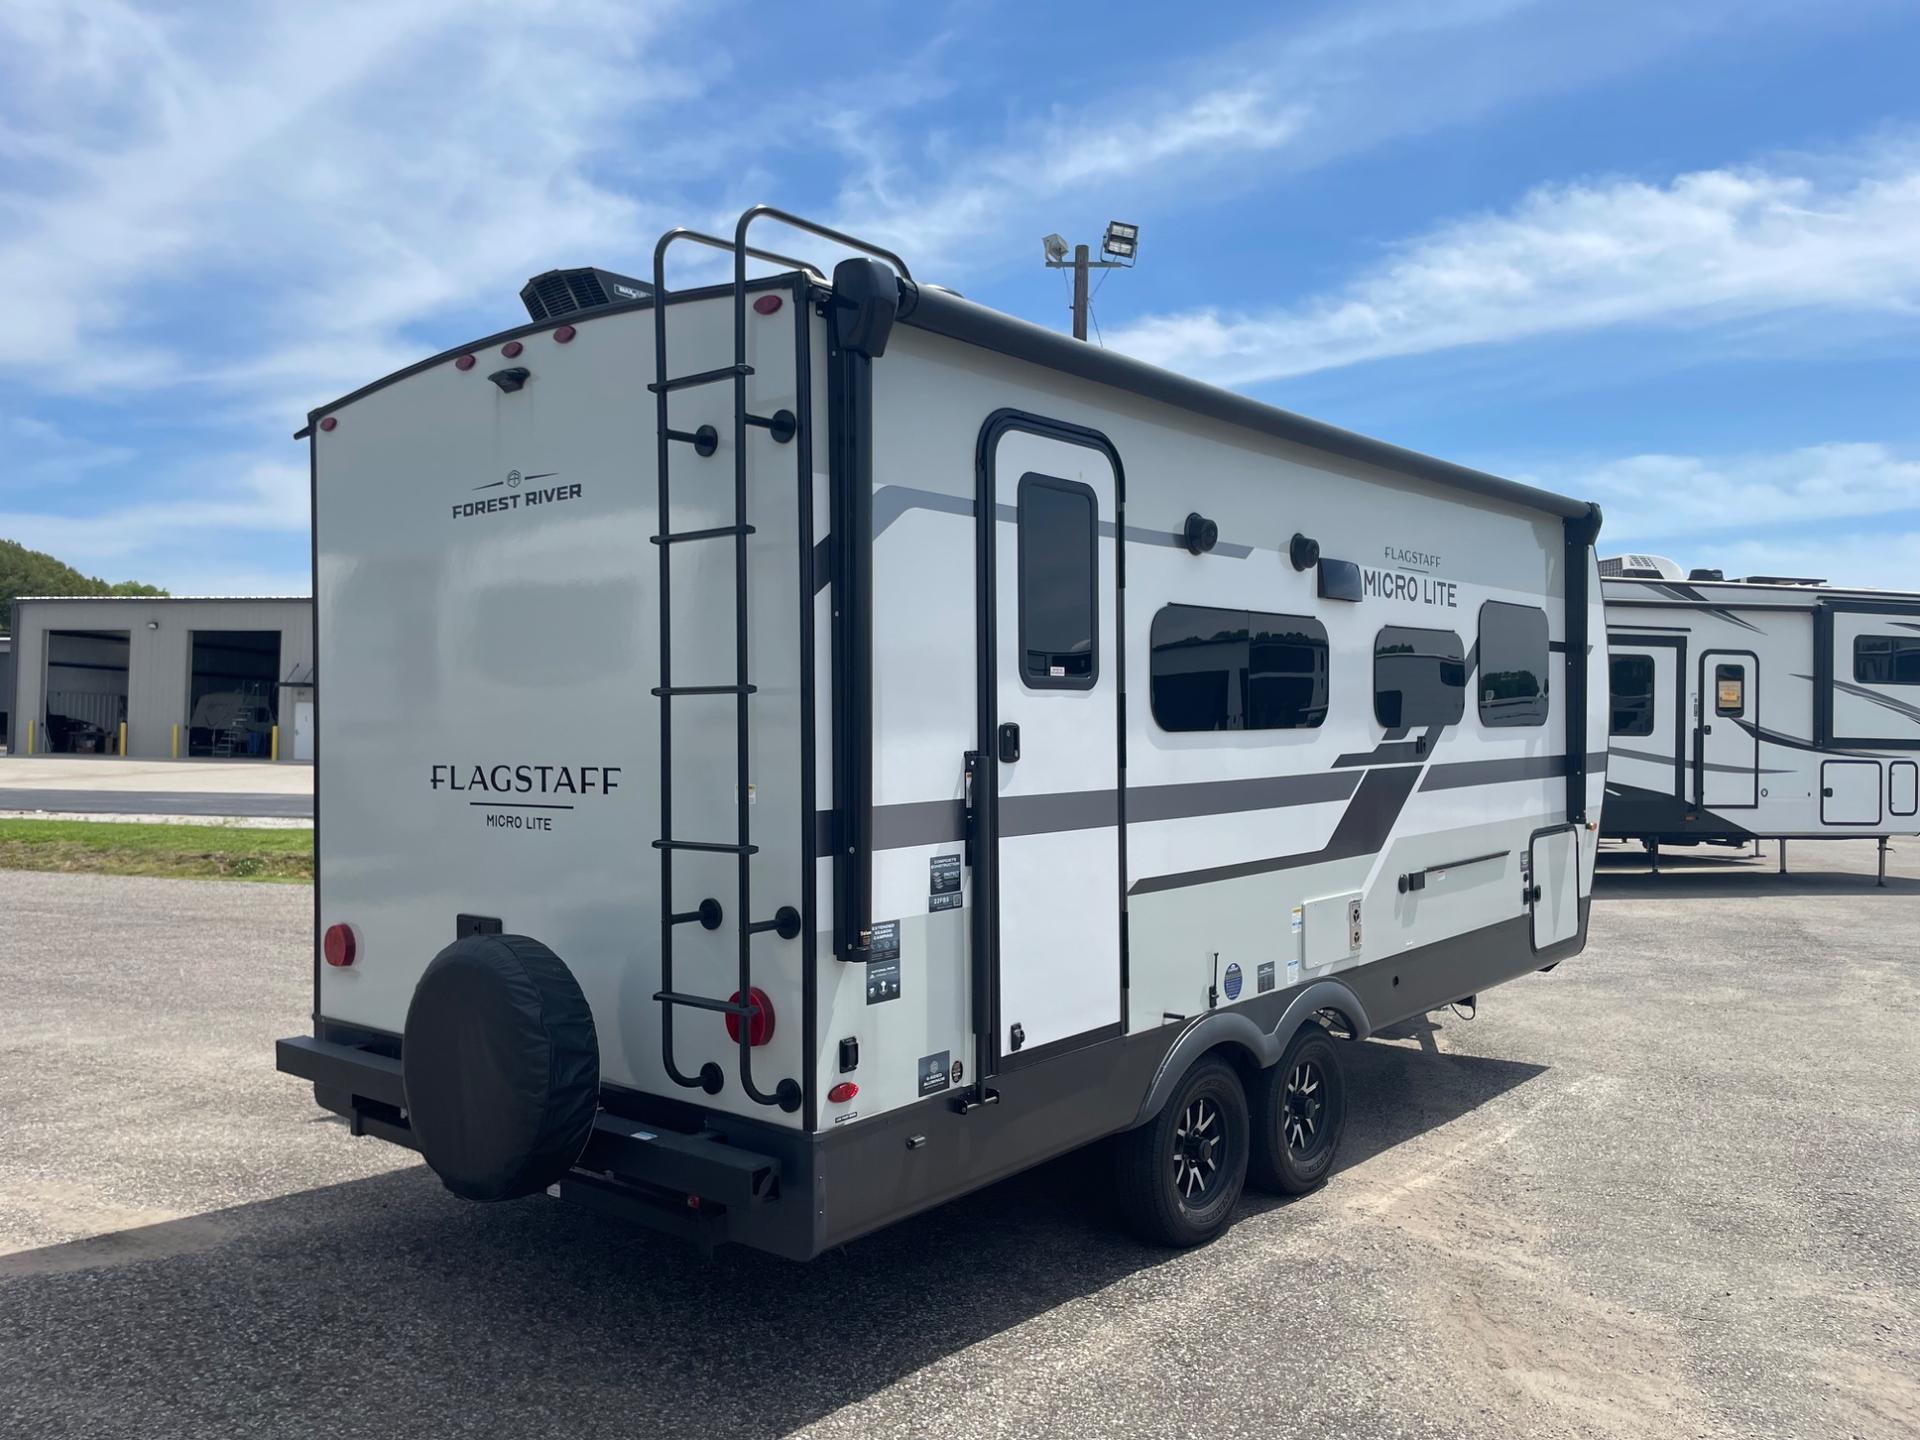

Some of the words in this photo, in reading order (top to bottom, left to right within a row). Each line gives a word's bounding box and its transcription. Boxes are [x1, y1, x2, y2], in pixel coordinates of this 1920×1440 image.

[452, 494, 521, 519] FOREST
[525, 483, 582, 506] RIVER
[1384, 546, 1441, 568] FLAGSTAFF
[1364, 569, 1418, 602] MICRO
[1424, 579, 1457, 608] LITE
[430, 765, 622, 795] FLAGSTAFF
[486, 814, 522, 829] MICRO
[526, 817, 552, 831] LITE
